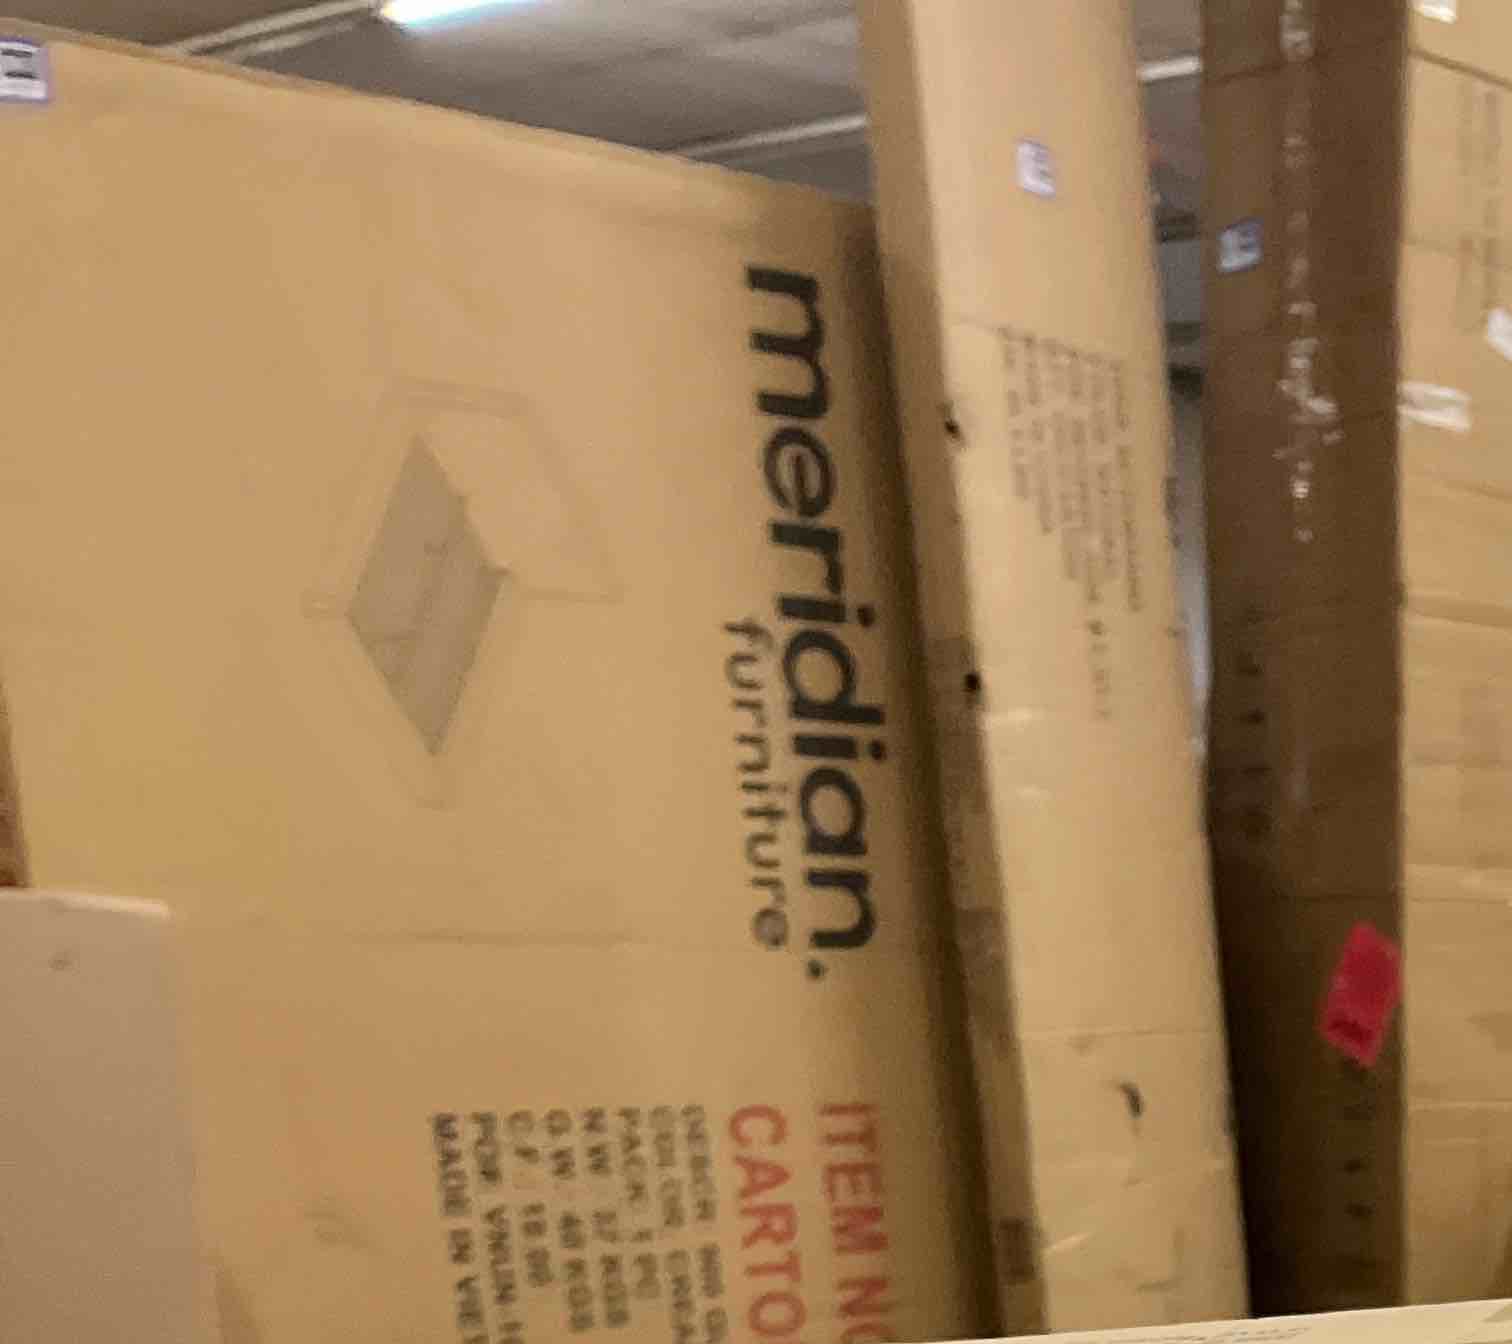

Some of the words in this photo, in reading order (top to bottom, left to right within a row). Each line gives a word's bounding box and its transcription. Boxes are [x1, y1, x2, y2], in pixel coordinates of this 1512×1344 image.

[722, 618, 789, 951] furniture
[450, 1230, 477, 1264] IN
[821, 1104, 889, 1254] ITEM
